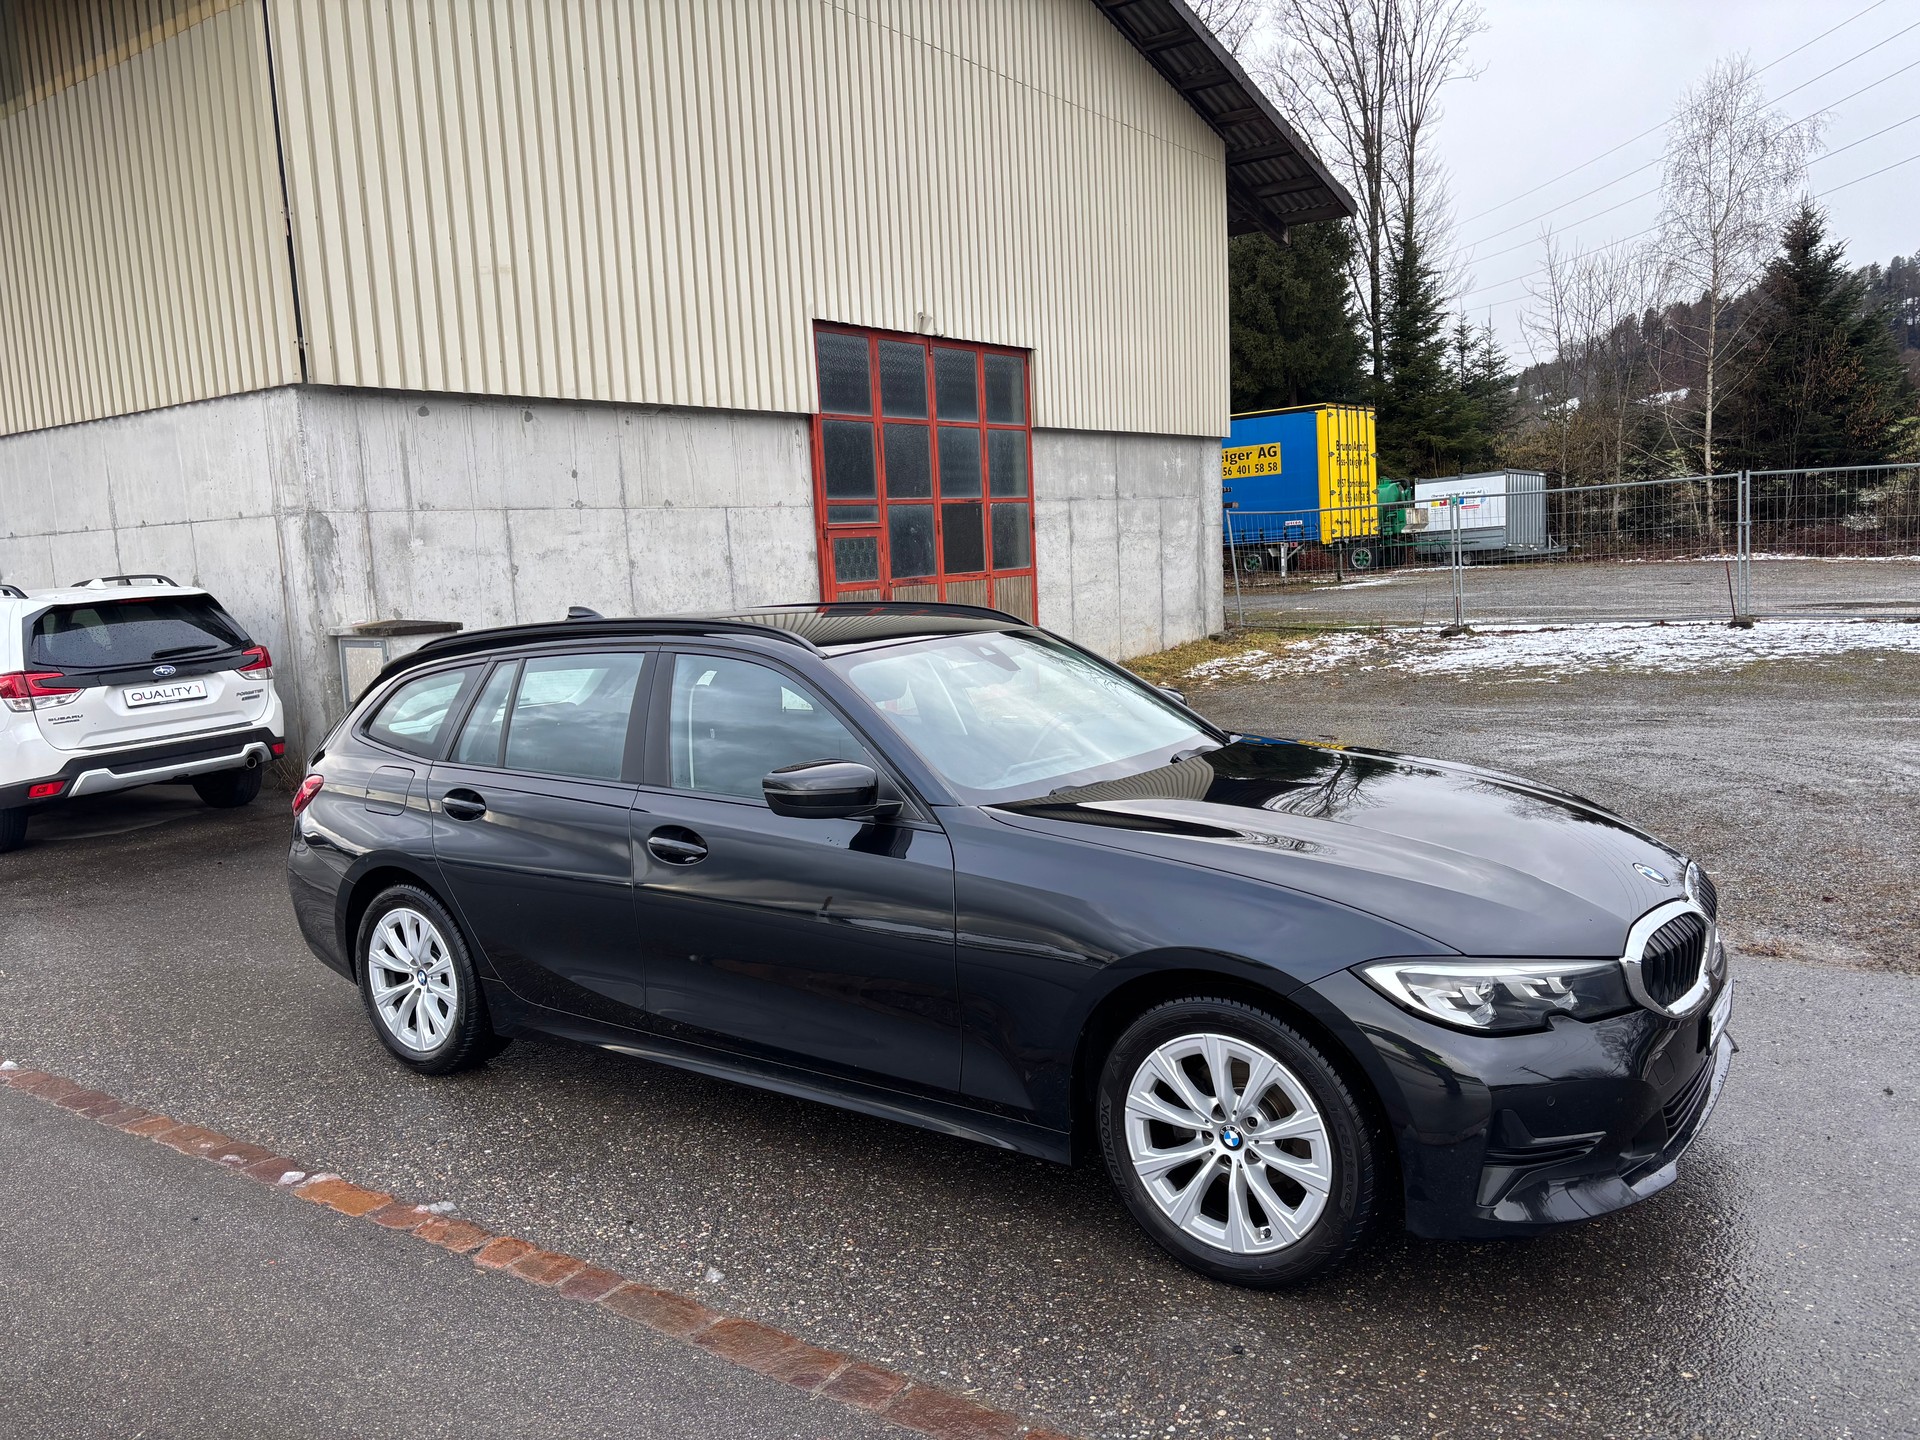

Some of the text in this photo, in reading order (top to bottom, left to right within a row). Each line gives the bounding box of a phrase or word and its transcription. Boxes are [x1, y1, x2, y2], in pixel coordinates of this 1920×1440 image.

[1222, 446, 1277, 465] iger AG
[1237, 464, 1251, 475] 401
[1255, 463, 1265, 473] 58
[1268, 462, 1278, 472] 58
[131, 686, 192, 702] QUALITY
